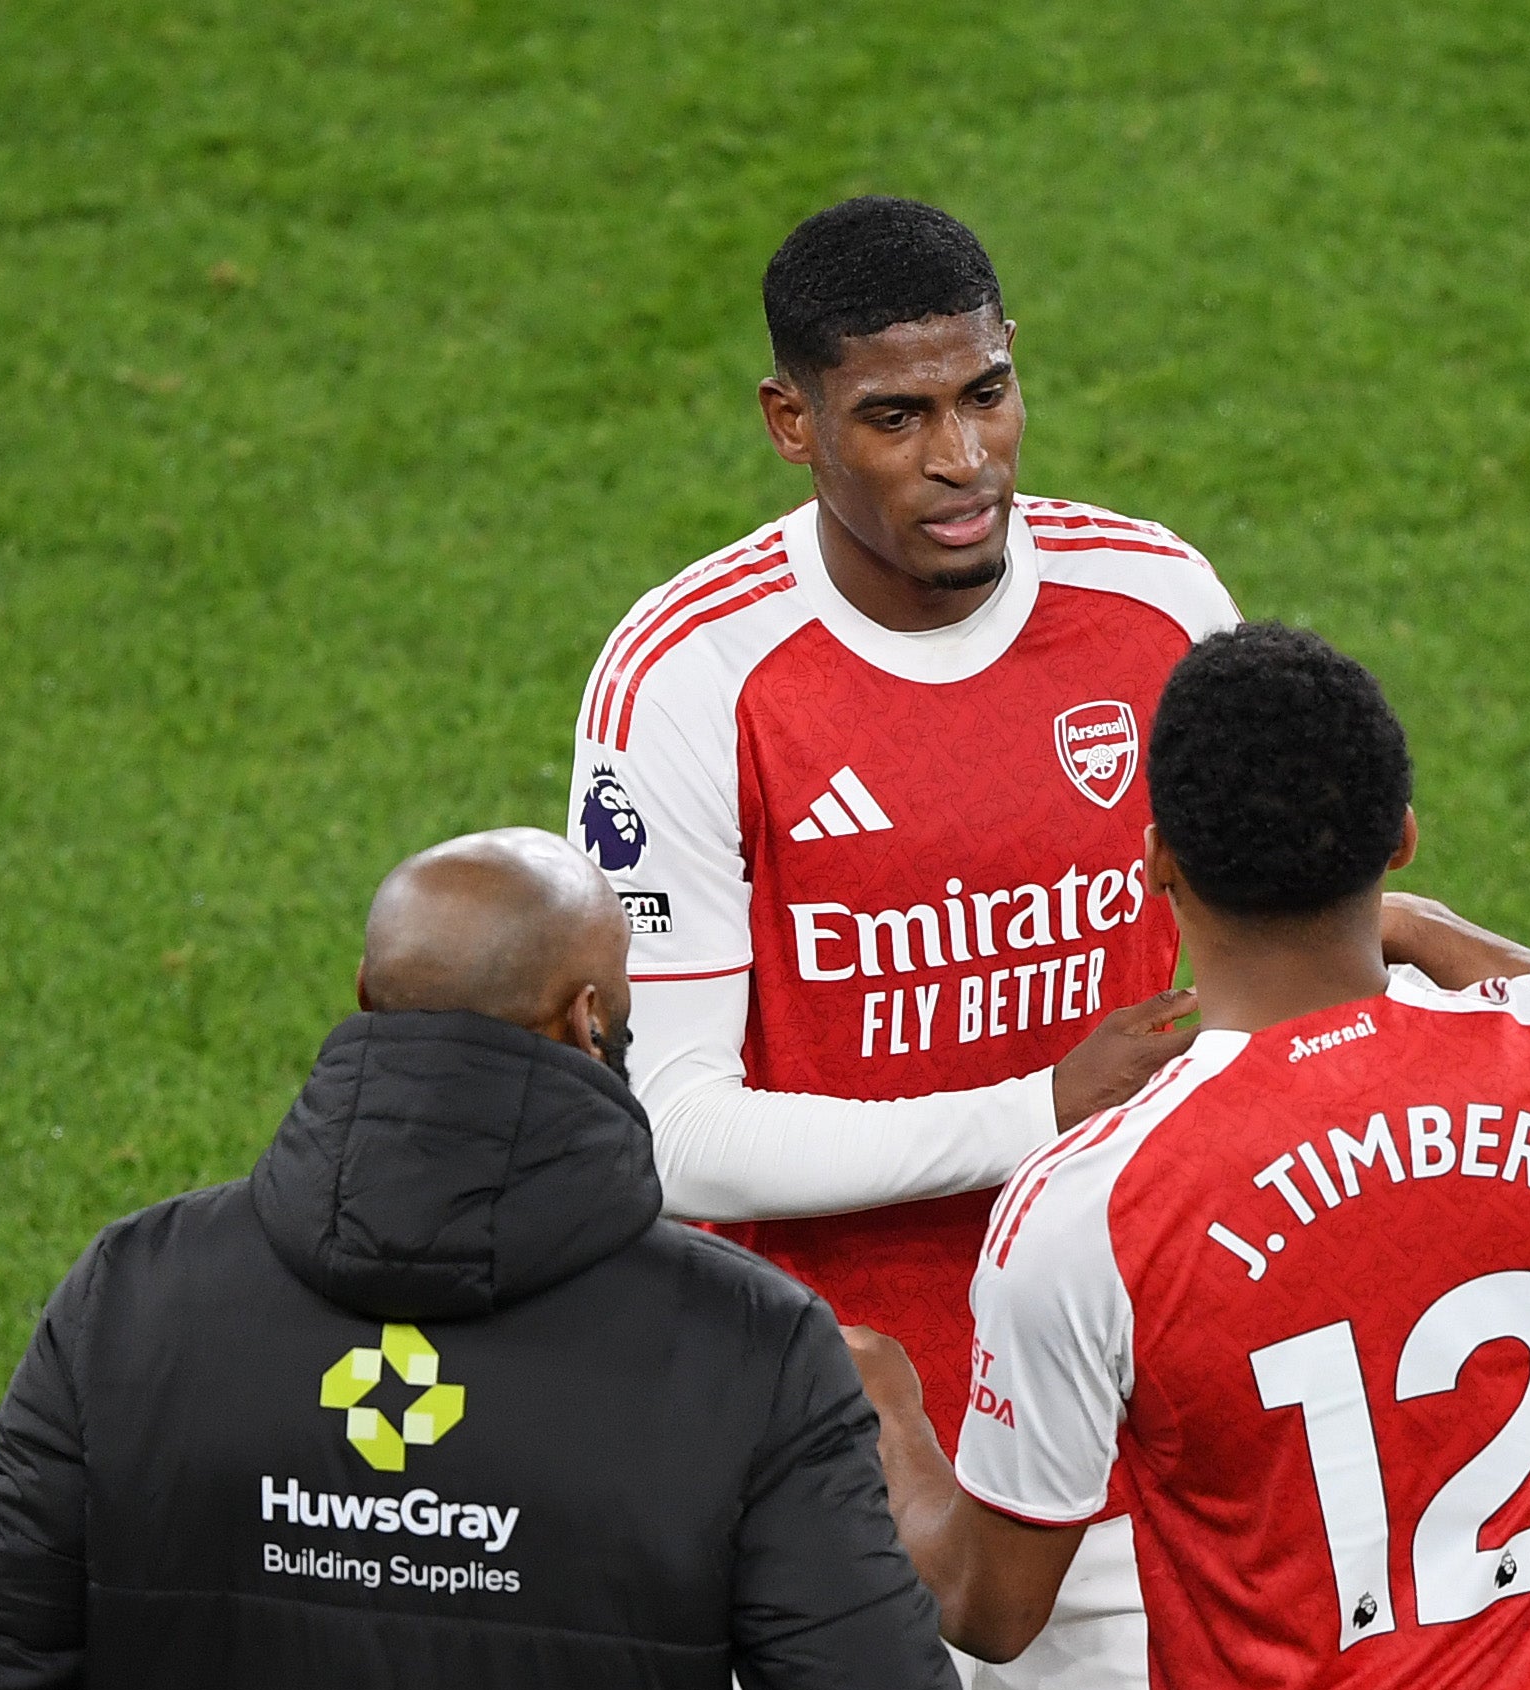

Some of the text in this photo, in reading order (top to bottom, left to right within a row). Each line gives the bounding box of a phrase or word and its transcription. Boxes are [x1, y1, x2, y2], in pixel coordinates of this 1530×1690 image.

[1067, 716, 1126, 742] Arsenal
[786, 858, 1144, 982] Emirates
[860, 947, 1106, 1058] FLY BETTER
[1287, 1011, 1378, 1064] Arsenal
[1206, 1220, 1286, 1282] J.
[261, 1475, 520, 1552] HuwsGray
[263, 1543, 521, 1594] Building Supplies
